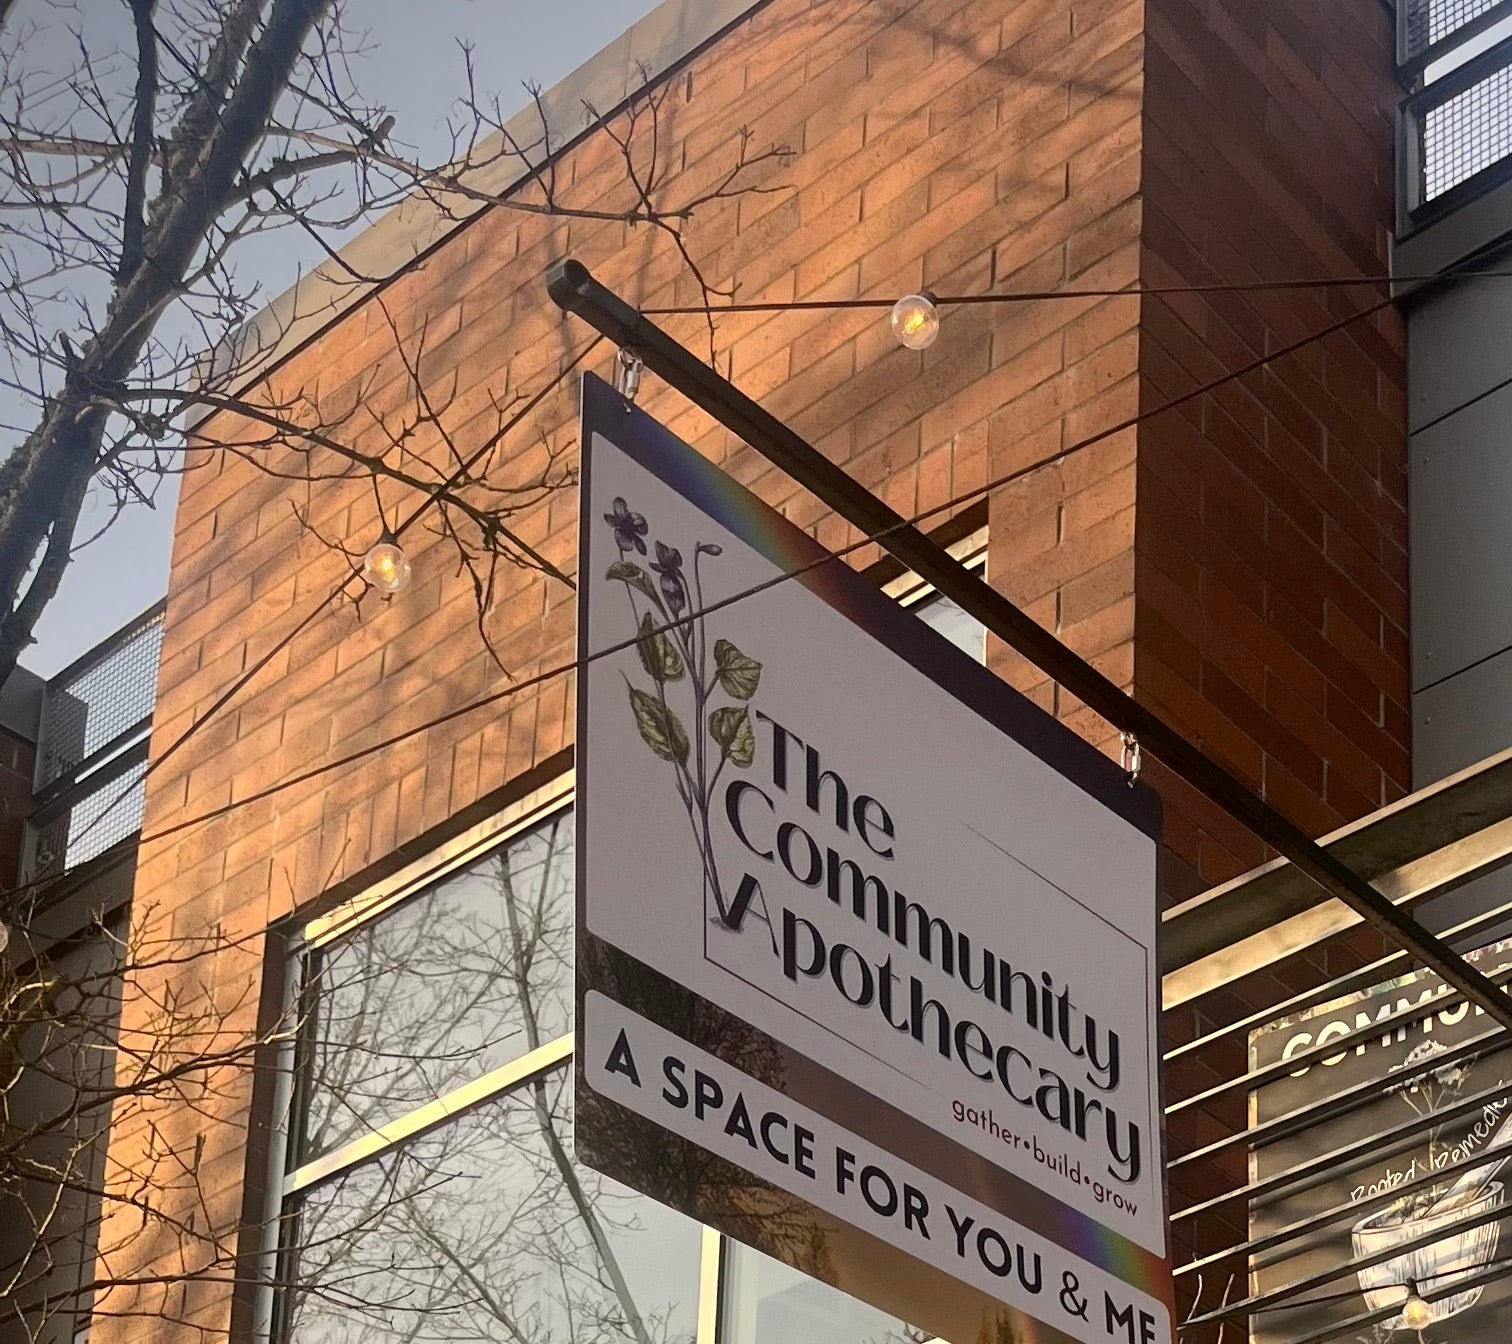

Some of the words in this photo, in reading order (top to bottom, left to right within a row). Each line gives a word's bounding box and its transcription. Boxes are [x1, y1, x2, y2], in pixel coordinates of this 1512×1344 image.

[756, 709, 895, 859] The
[724, 779, 1120, 1091] Community
[726, 872, 1141, 1184] Apothecary
[604, 1027, 642, 1088] A
[661, 1055, 816, 1180] SPACE
[835, 1146, 931, 1240] FOR
[944, 1203, 1043, 1295] YOU
[1059, 1270, 1090, 1321] &
[1434, 1080, 1509, 1170] Remedie
